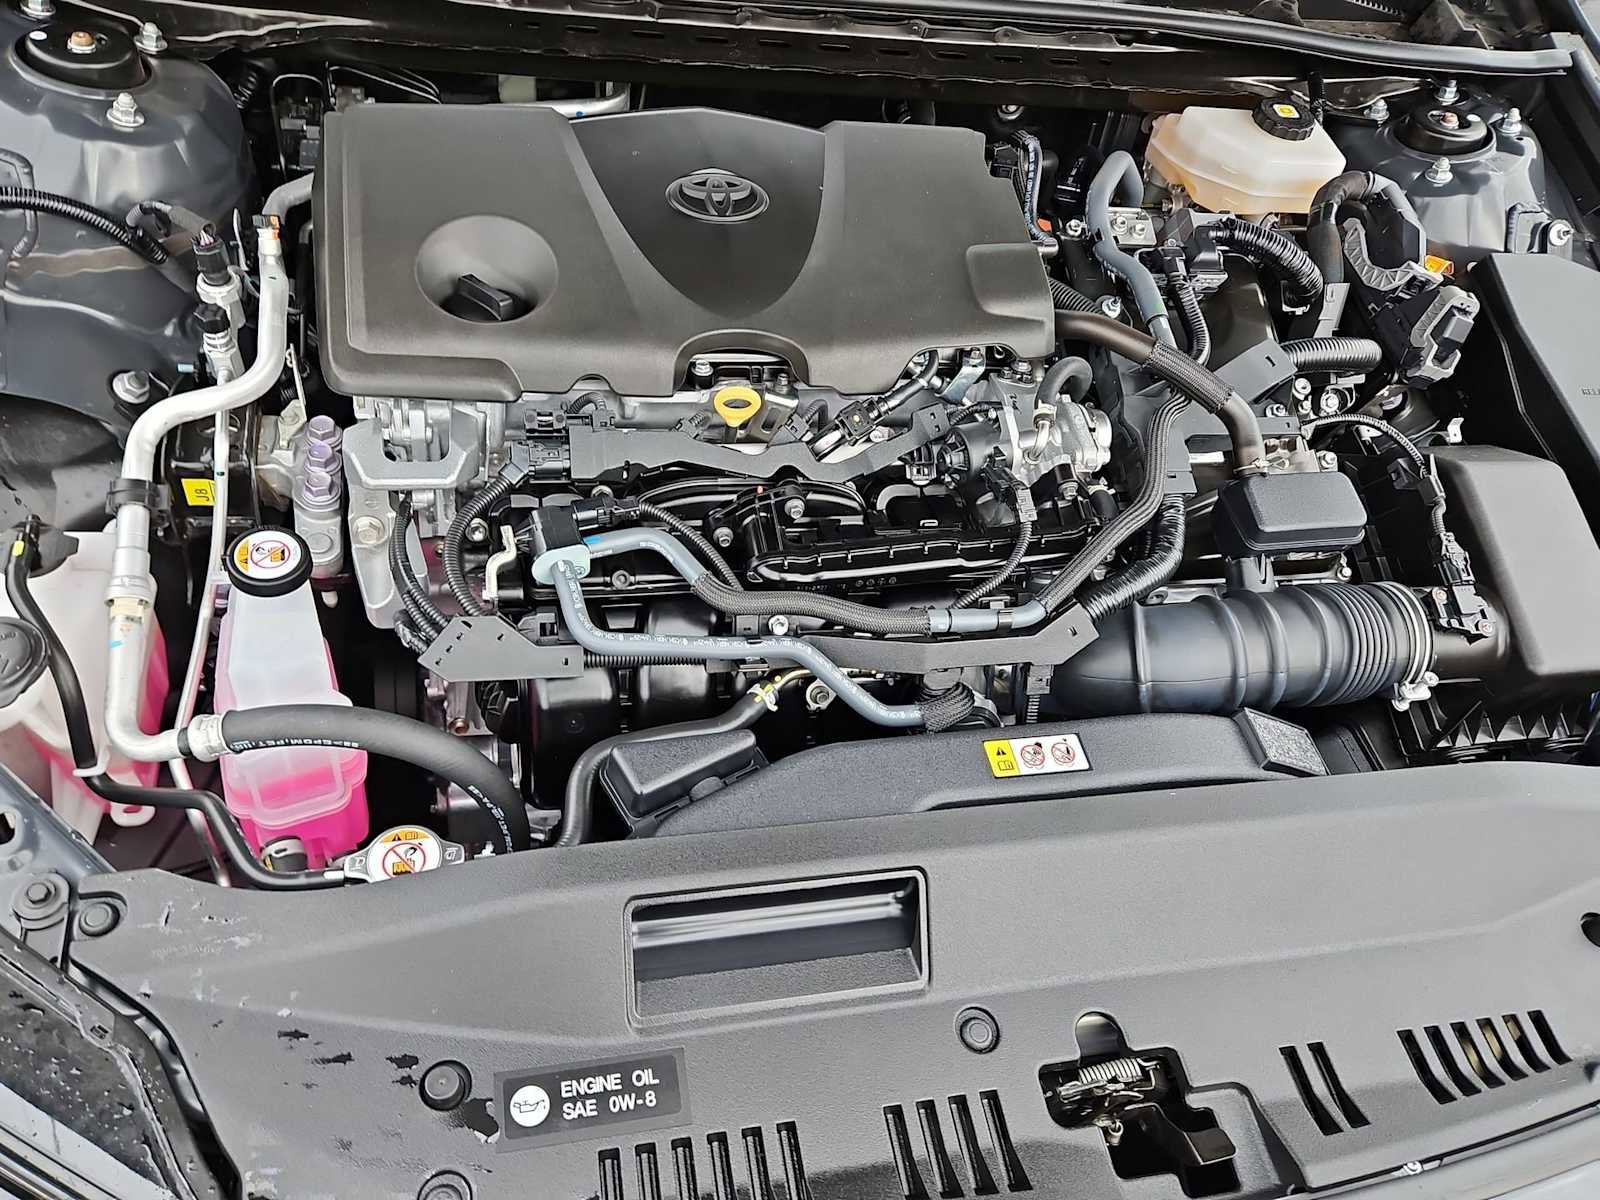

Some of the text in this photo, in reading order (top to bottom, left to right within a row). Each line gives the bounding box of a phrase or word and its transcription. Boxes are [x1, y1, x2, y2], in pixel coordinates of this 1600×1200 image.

[561, 1069, 659, 1098] ENGINE OIL
[563, 1091, 656, 1120] SAE 0W-8
